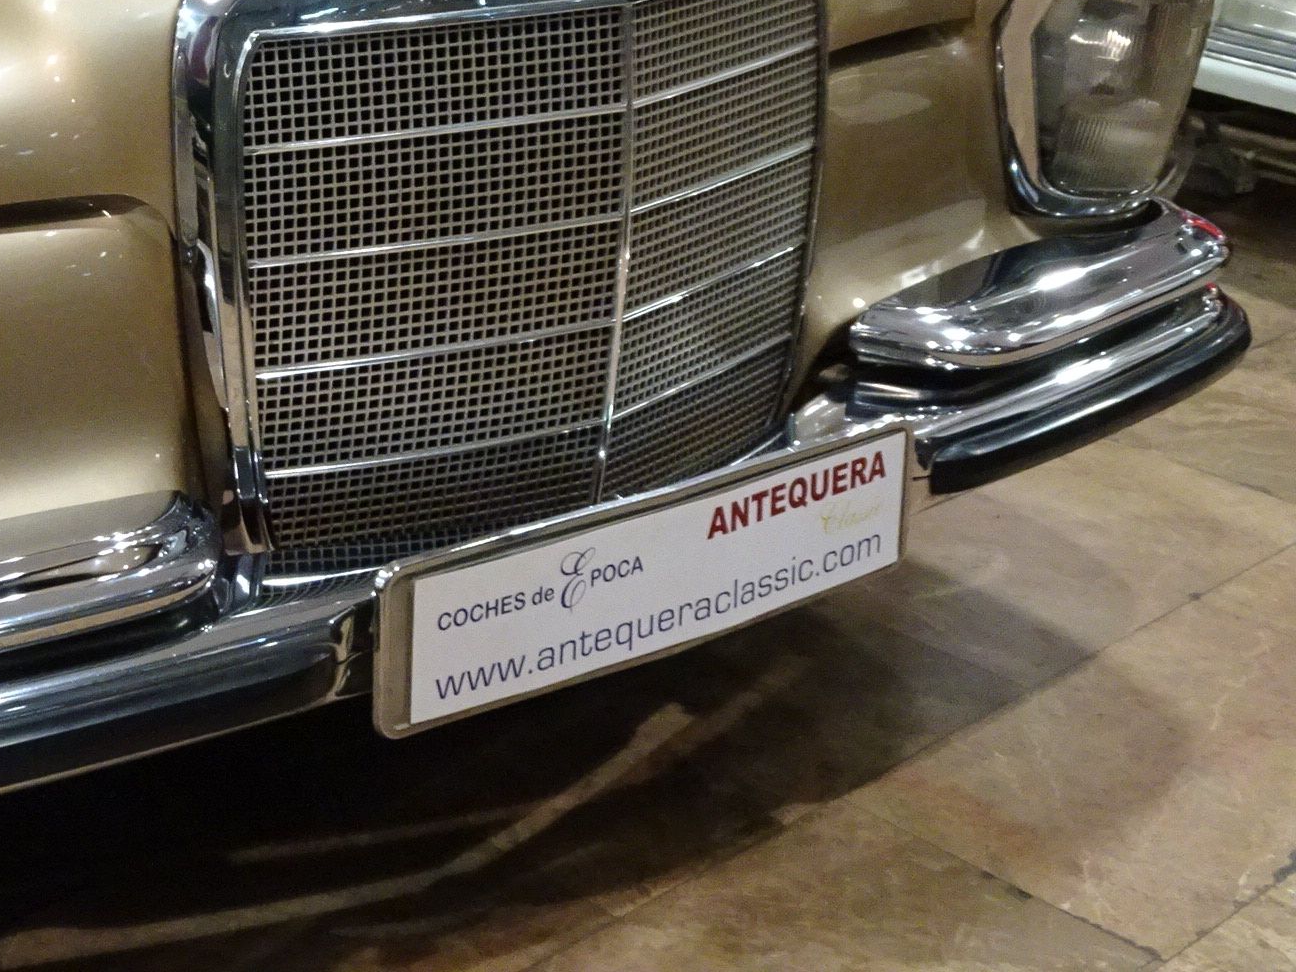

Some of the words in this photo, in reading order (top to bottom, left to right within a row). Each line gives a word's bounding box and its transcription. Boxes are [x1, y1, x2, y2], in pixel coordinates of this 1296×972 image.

[706, 450, 887, 539] ANTEQUERA
[435, 532, 882, 700] www.antequeraclassic.com
[437, 592, 526, 631] COCHES
[532, 586, 554, 606] de
